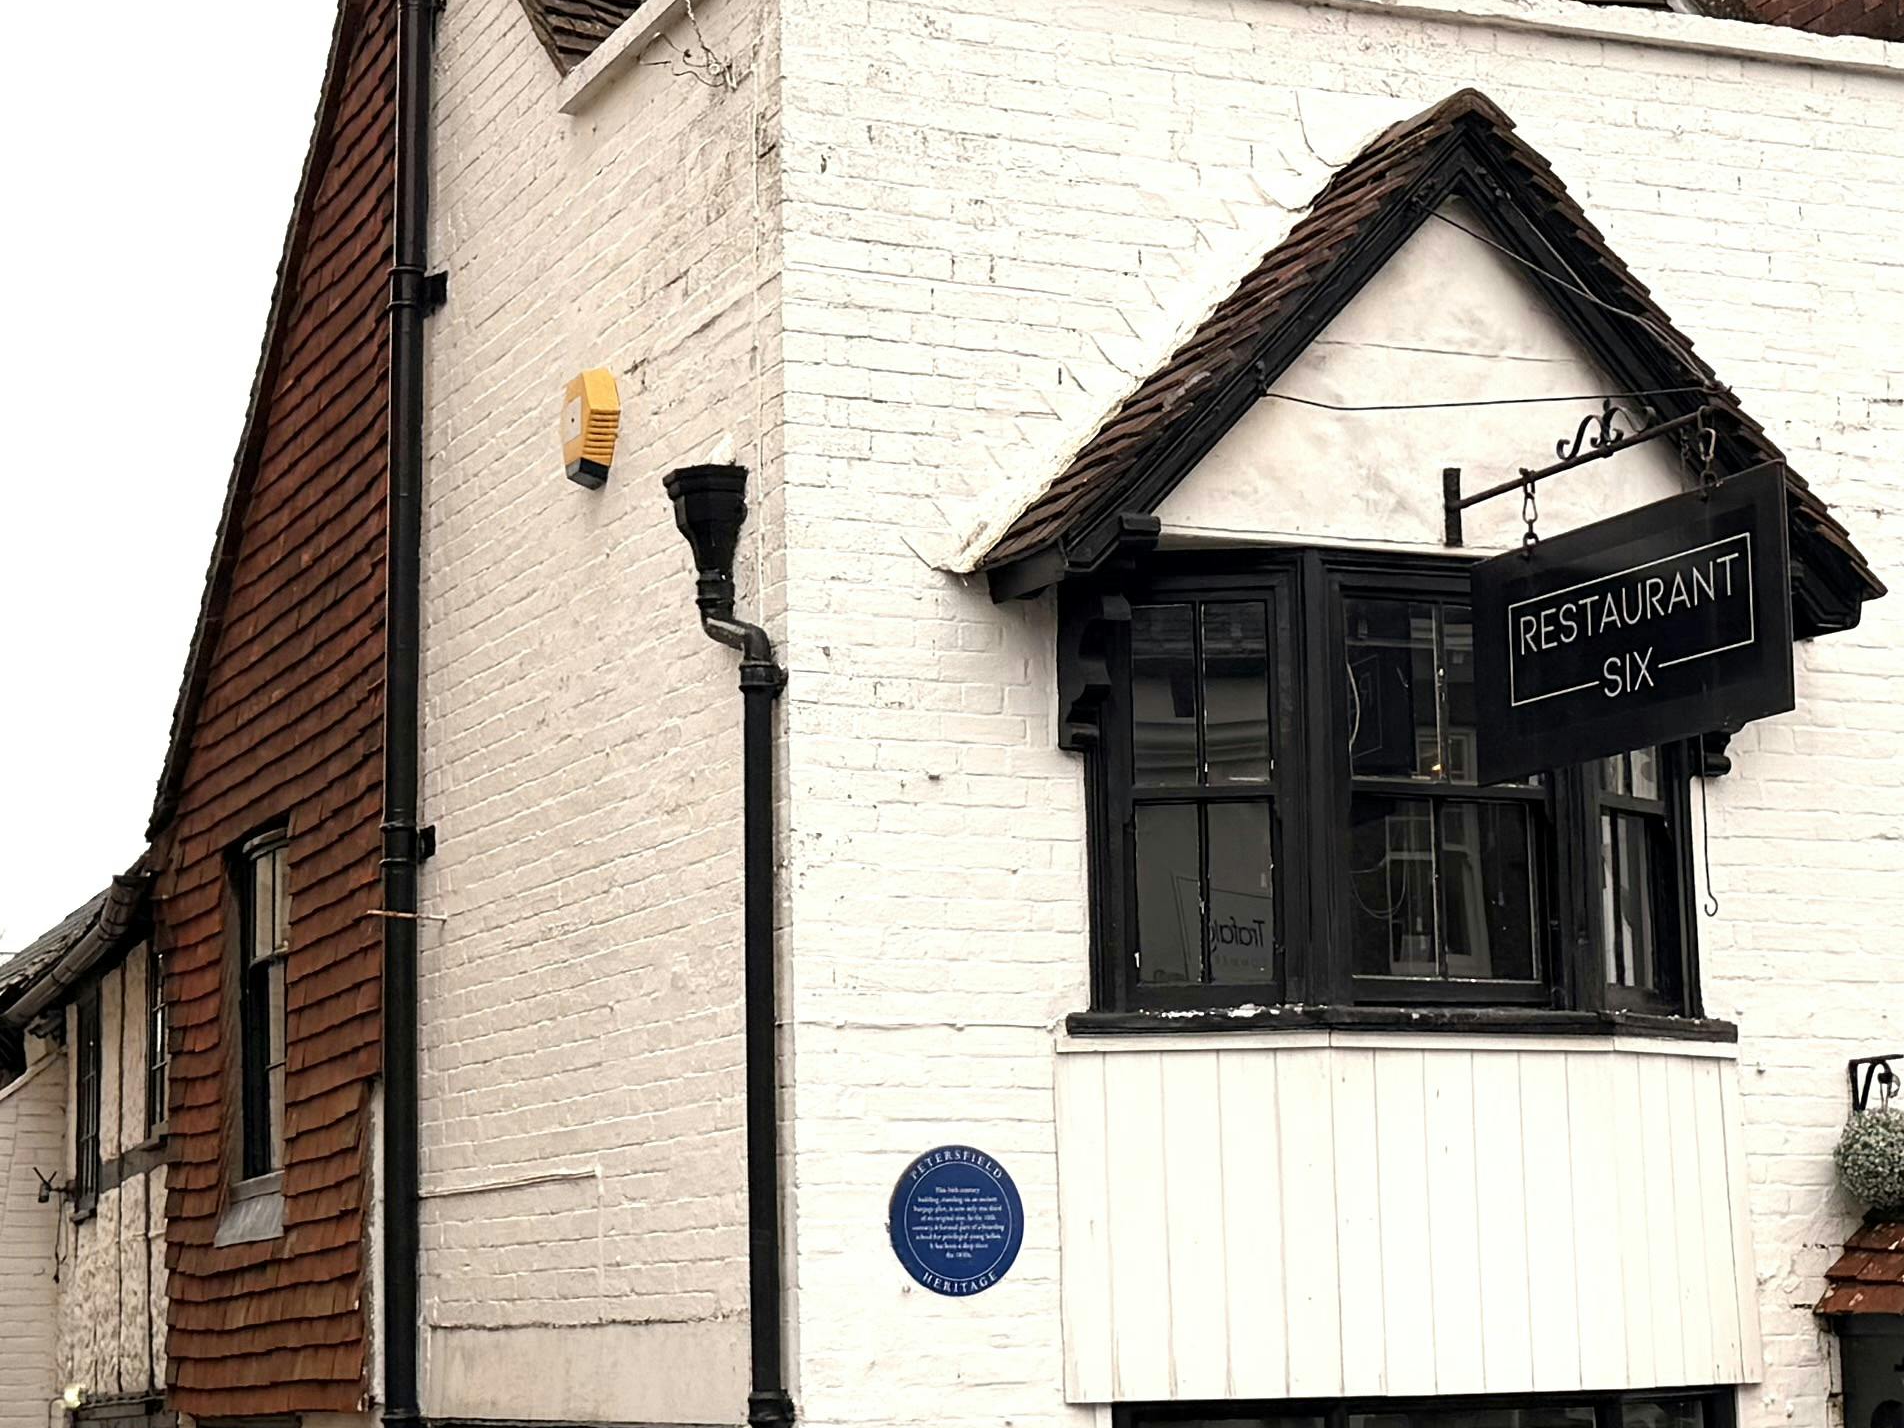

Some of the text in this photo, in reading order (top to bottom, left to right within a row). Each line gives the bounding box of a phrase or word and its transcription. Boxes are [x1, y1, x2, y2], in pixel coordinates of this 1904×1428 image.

[1520, 552, 1740, 656] RESTAURANT
[1602, 646, 1655, 698] SIX
[910, 1150, 1003, 1181] PETERSFIELD
[922, 1271, 998, 1293] HERITAGE
